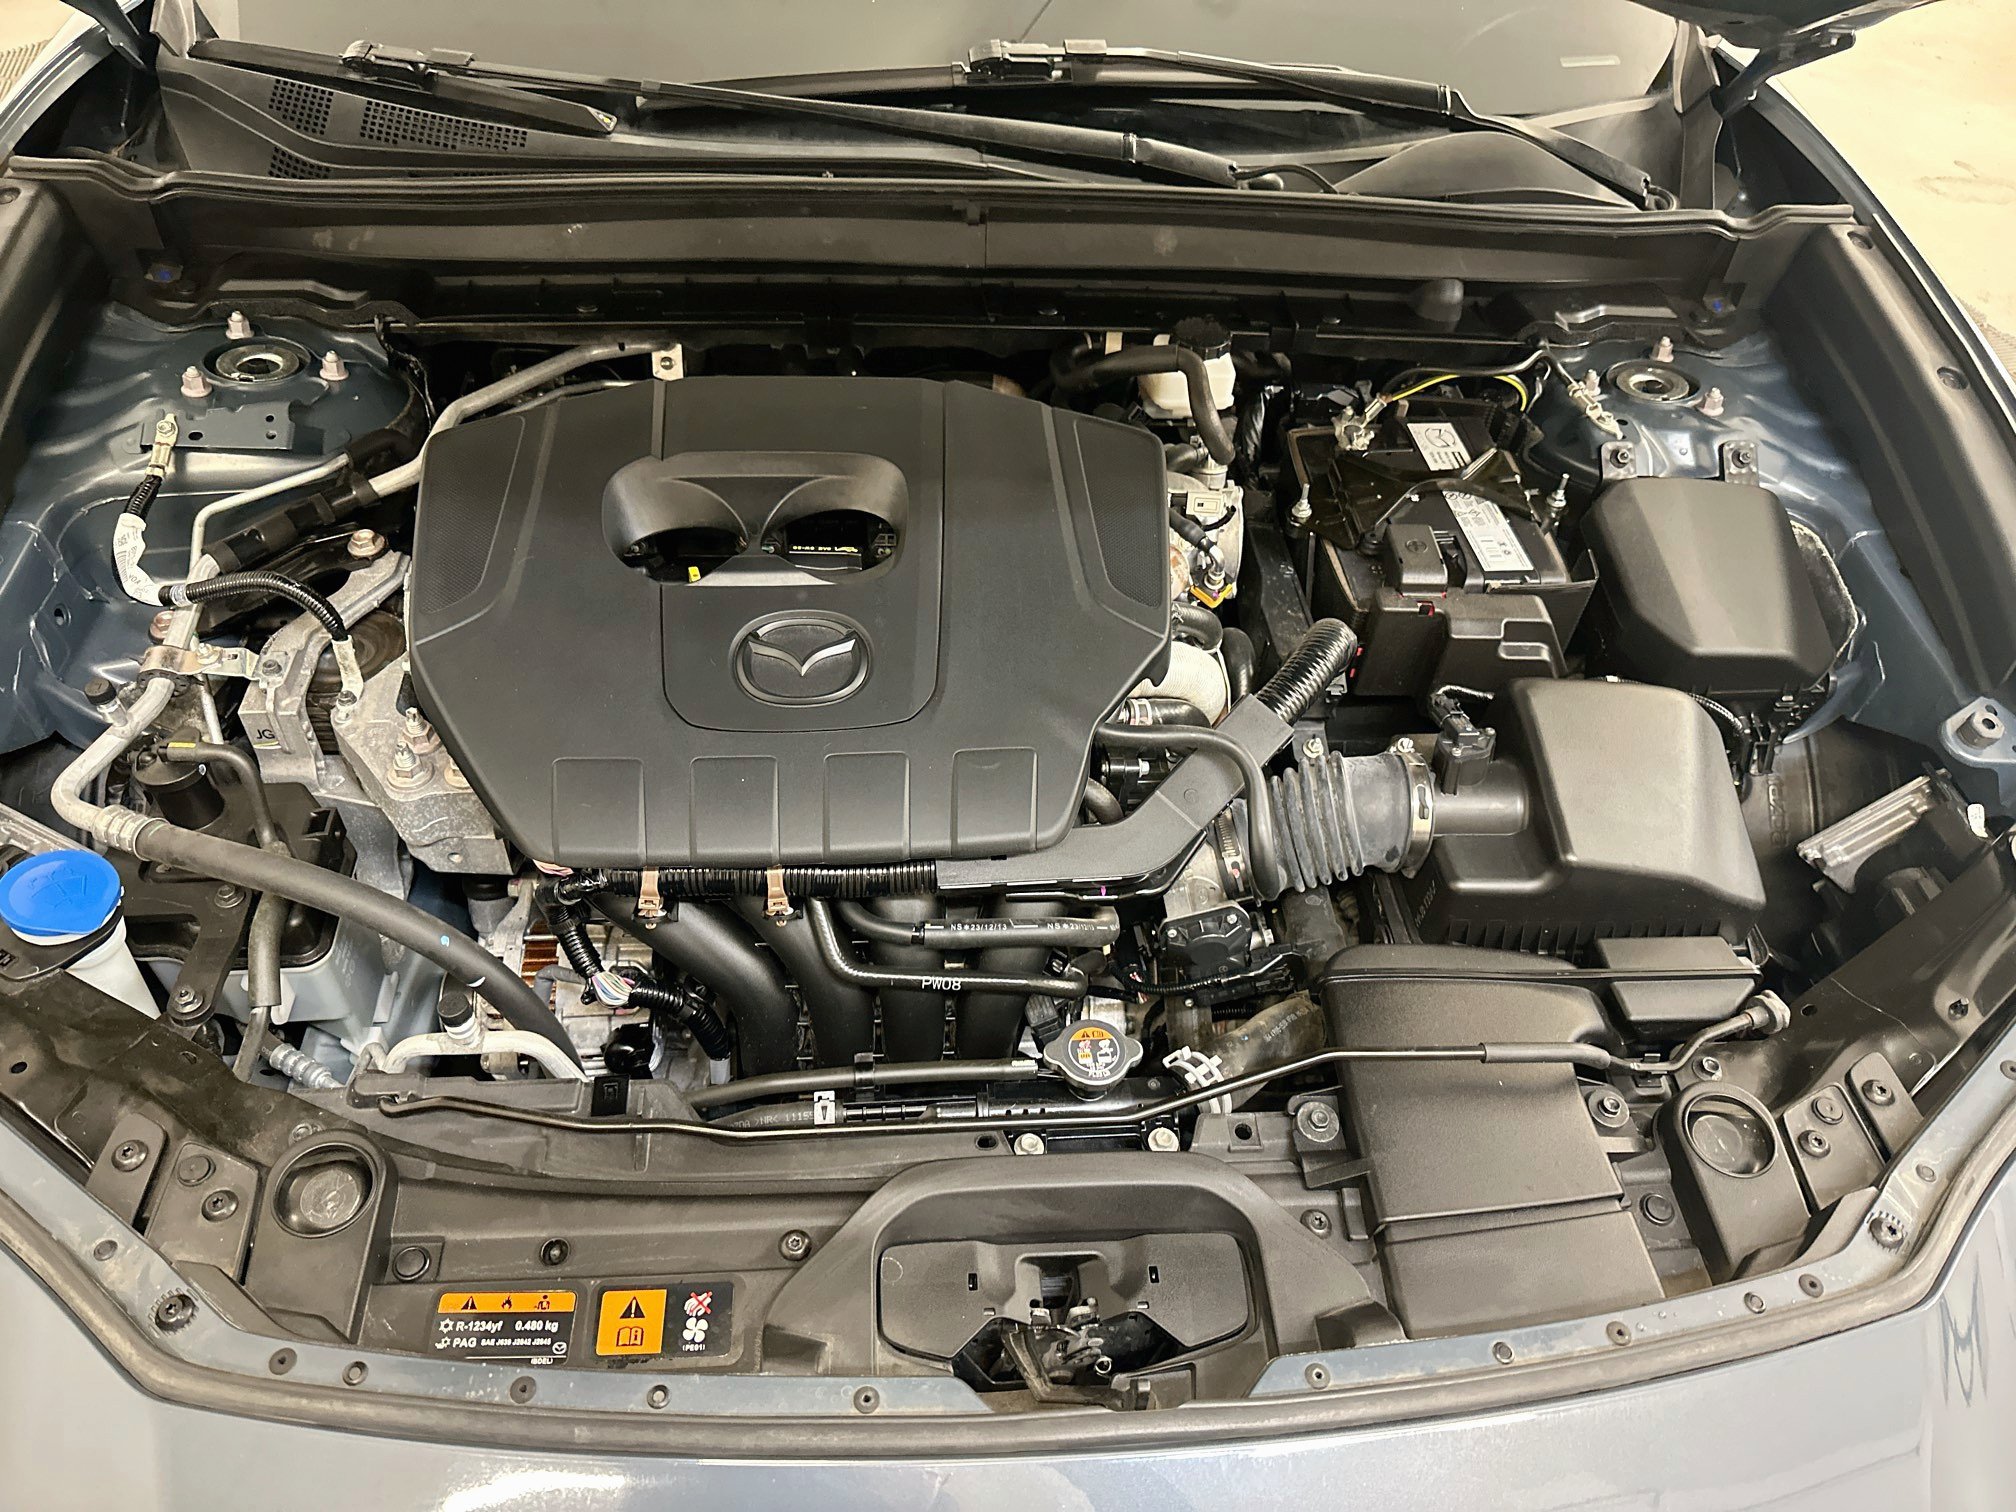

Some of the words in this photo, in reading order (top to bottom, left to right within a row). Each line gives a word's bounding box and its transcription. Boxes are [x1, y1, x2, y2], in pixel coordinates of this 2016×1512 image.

[256, 729, 275, 739] JG
[950, 923, 963, 931] NS
[921, 976, 962, 991] PW08
[455, 1320, 503, 1333] R-1234yf
[514, 1320, 542, 1332] 0.480
[544, 1320, 559, 1333] kg
[452, 1337, 478, 1348] PAG
